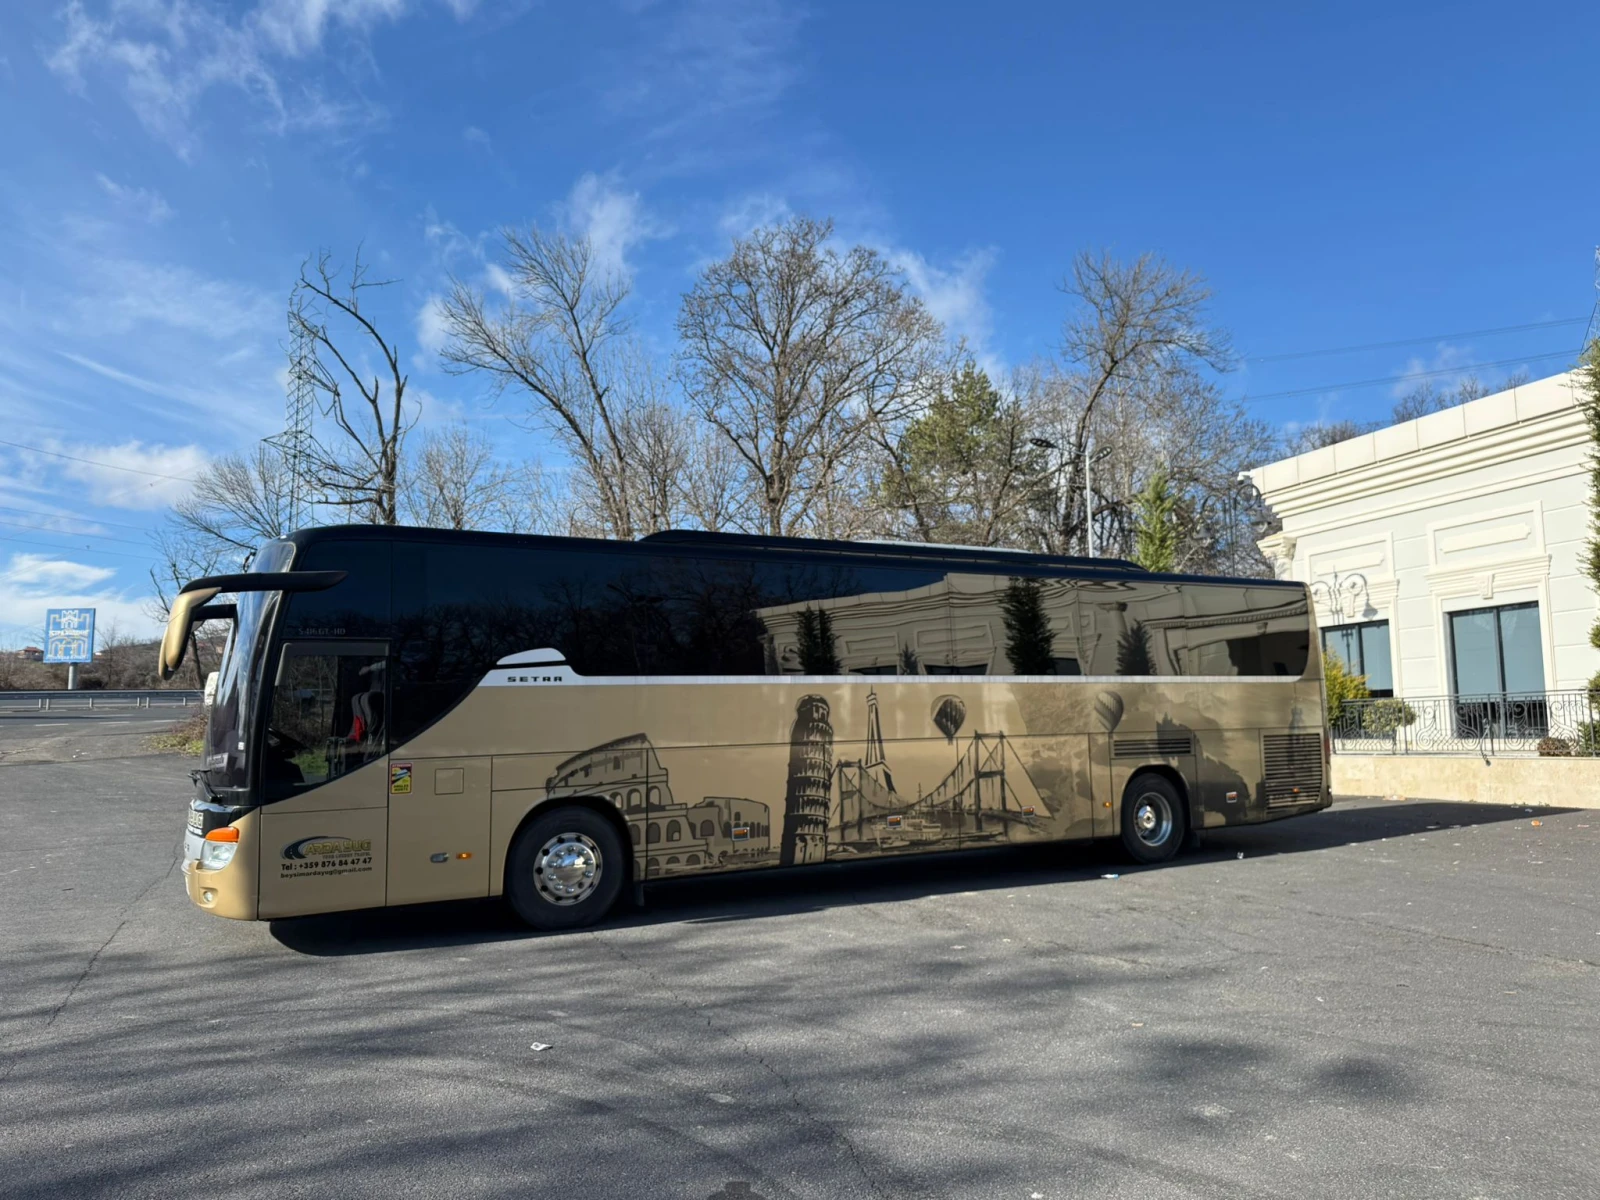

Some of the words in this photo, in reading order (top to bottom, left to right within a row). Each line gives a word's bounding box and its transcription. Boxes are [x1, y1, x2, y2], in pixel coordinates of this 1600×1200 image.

[304, 841, 342, 855] ARDA
[343, 839, 372, 852] YUG
[299, 861, 319, 869] +359
[321, 860, 336, 868] 876
